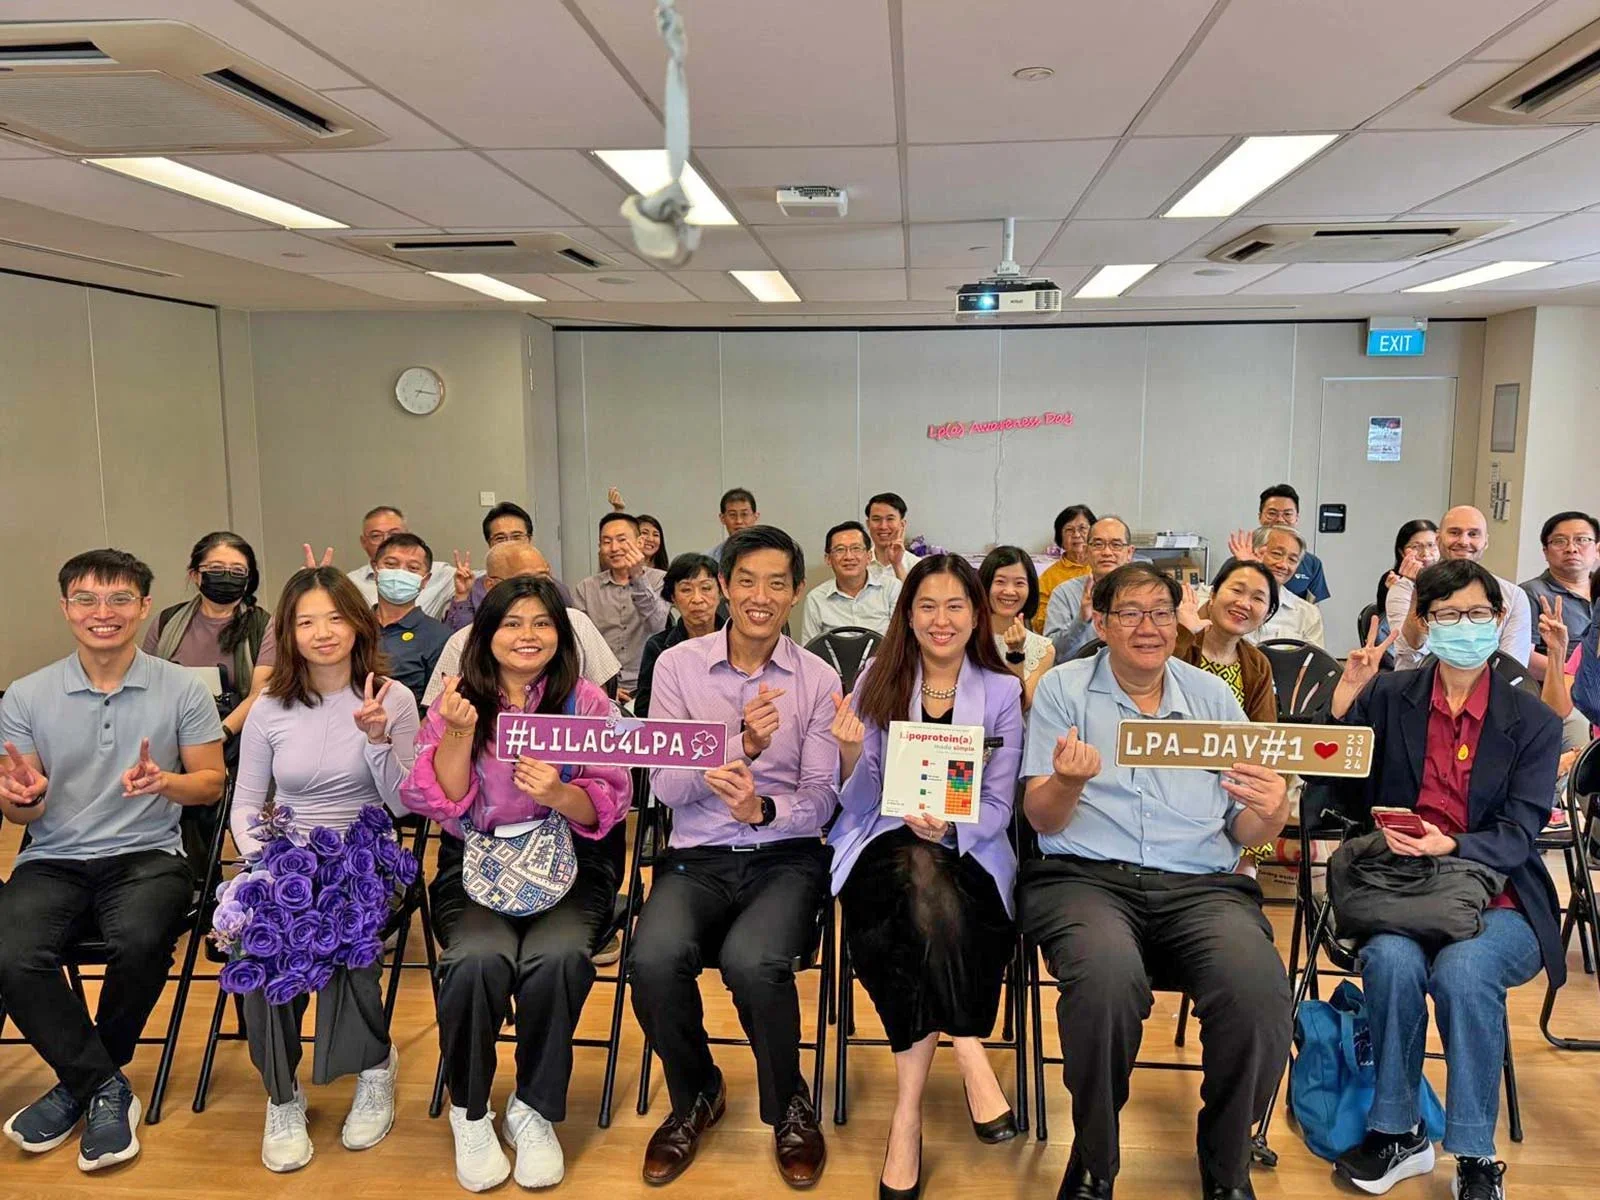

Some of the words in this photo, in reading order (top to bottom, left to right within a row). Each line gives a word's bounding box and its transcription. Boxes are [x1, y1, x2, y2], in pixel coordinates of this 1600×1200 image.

[1380, 335, 1412, 352] EXIT
[928, 423, 965, 440] Lp(a)
[969, 415, 1041, 435] Awareness
[1044, 411, 1074, 428] Day
[505, 719, 685, 757] #LILAC4LPA
[899, 731, 973, 745] Lipoprotein(a)
[1347, 734, 1364, 745] 23
[1345, 747, 1363, 758] 04
[1344, 758, 1361, 770] 24
